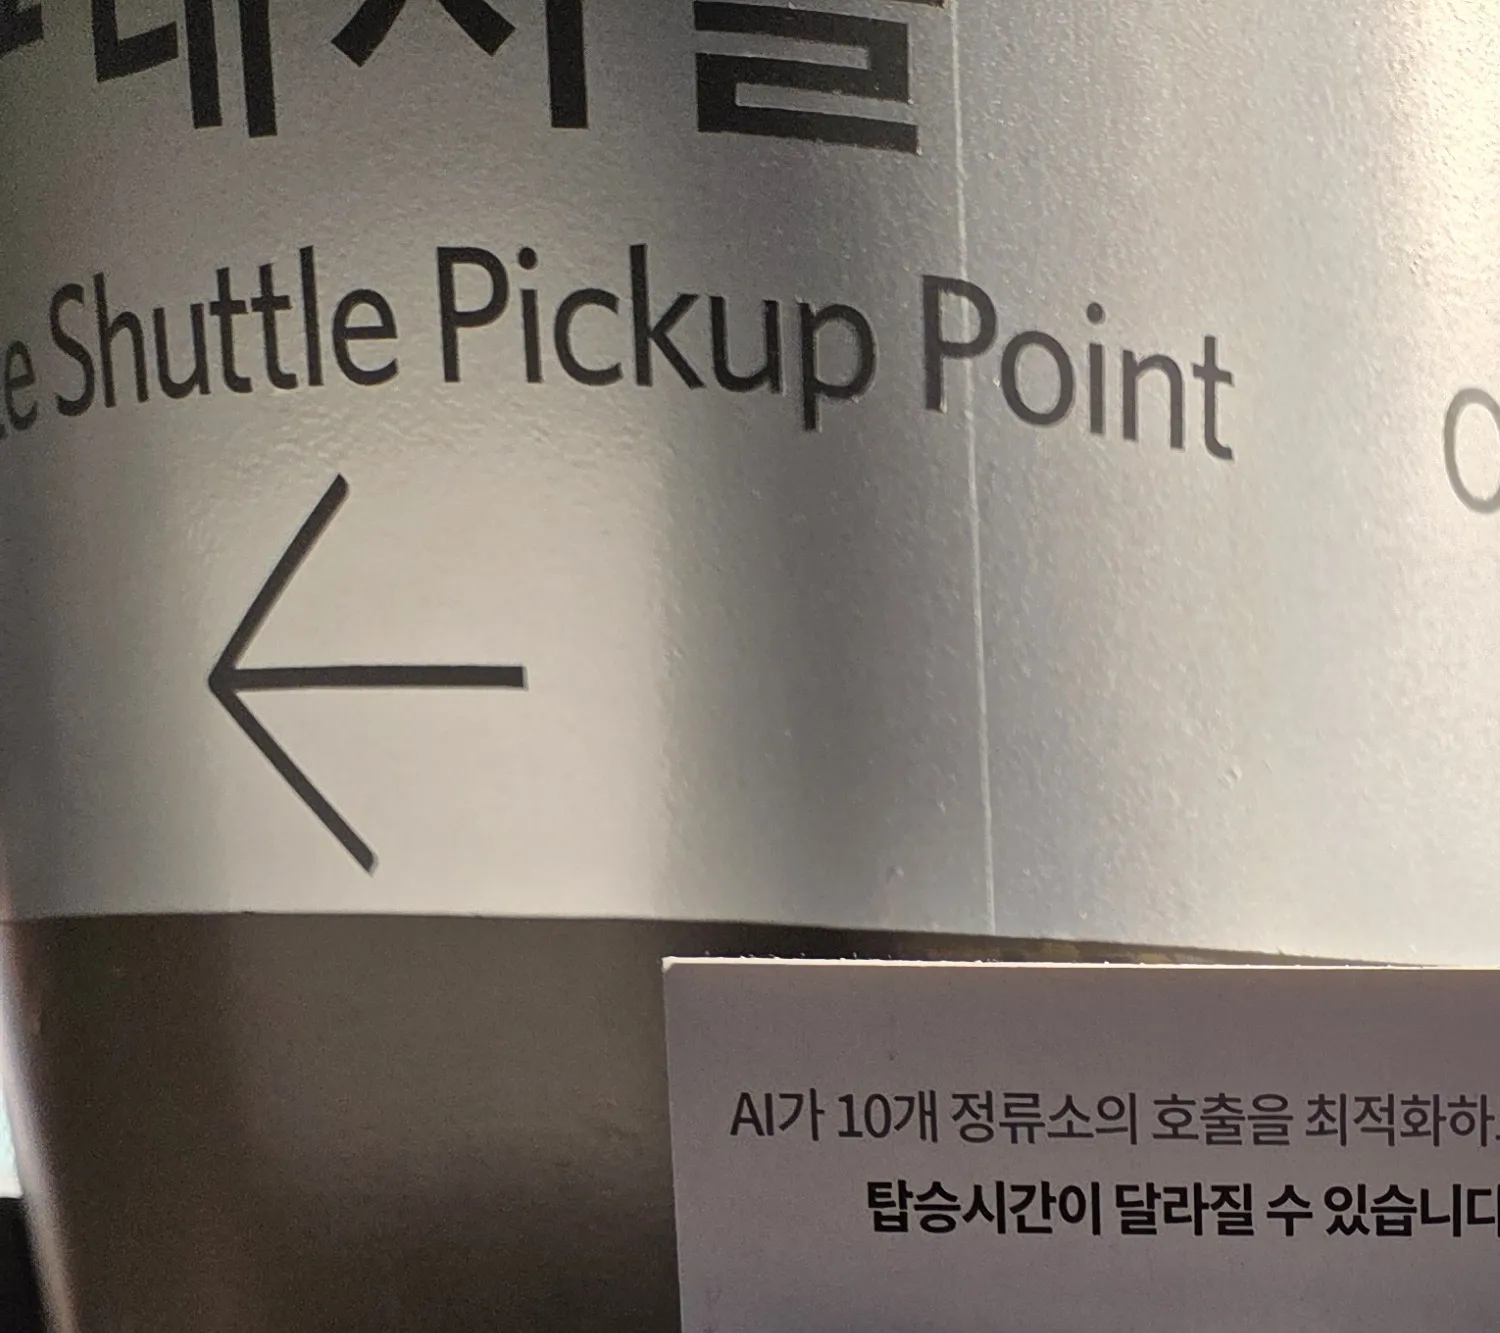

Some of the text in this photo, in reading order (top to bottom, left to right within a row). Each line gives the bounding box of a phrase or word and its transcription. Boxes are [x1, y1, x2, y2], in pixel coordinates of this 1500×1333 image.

[50, 244, 1234, 462] Shuttle Pickup Point
[730, 1090, 823, 1143] AI가
[837, 1090, 939, 1145] 10개
[951, 1090, 1138, 1146] 정류소의
[1153, 1092, 1293, 1147] 호출을
[867, 1179, 1100, 1236] 탑승시간이
[1114, 1181, 1253, 1238] 달라질
[1267, 1186, 1312, 1238] 수
